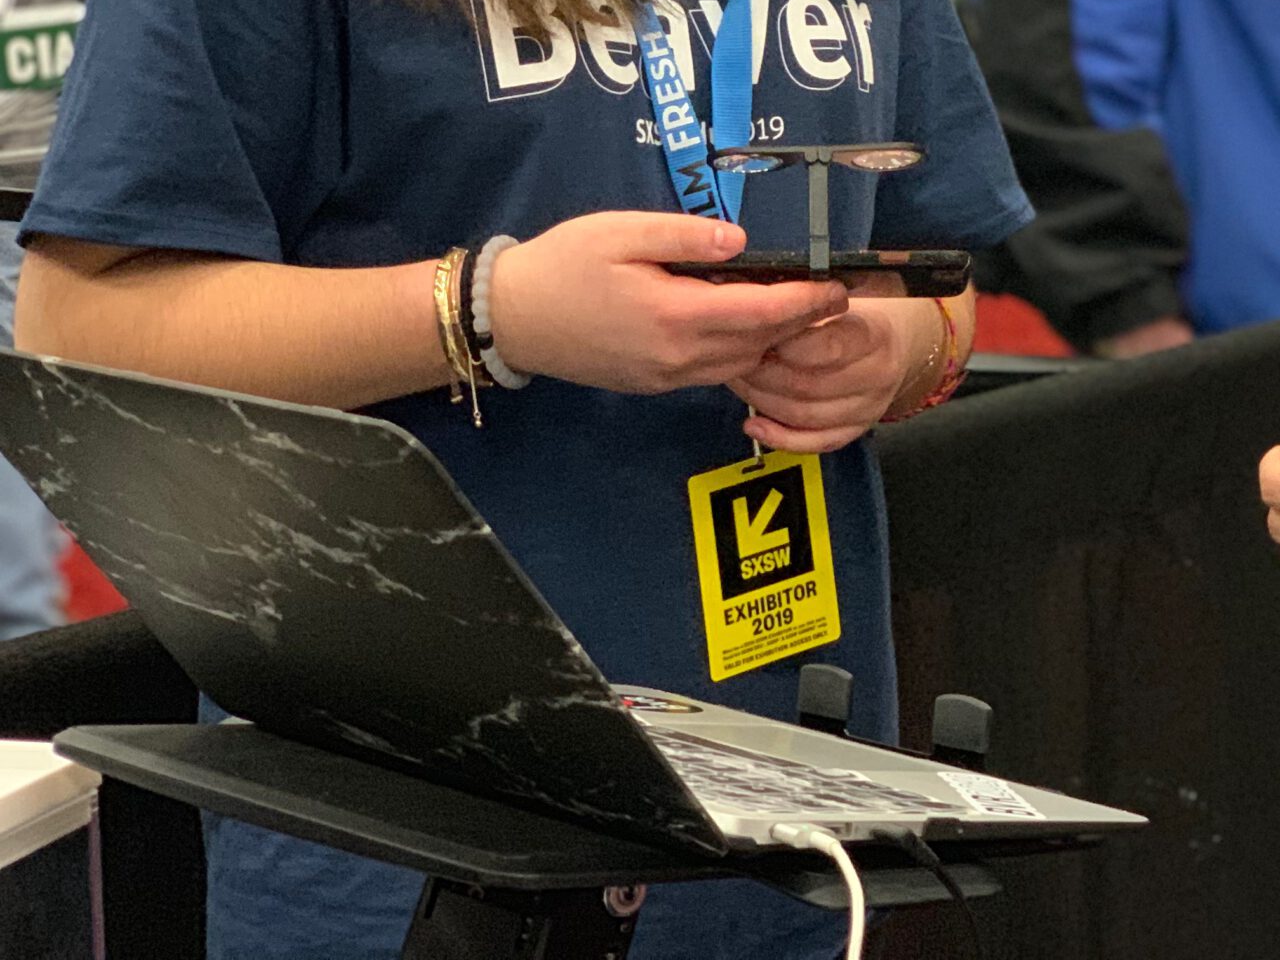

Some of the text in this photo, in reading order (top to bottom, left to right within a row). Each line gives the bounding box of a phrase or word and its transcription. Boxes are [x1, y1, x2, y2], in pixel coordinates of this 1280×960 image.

[642, 30, 702, 152] FRESH
[676, 159, 720, 220] LM
[740, 546, 791, 580] SXSW
[723, 580, 818, 626] EXHIBITOR
[752, 607, 794, 636] 2019
